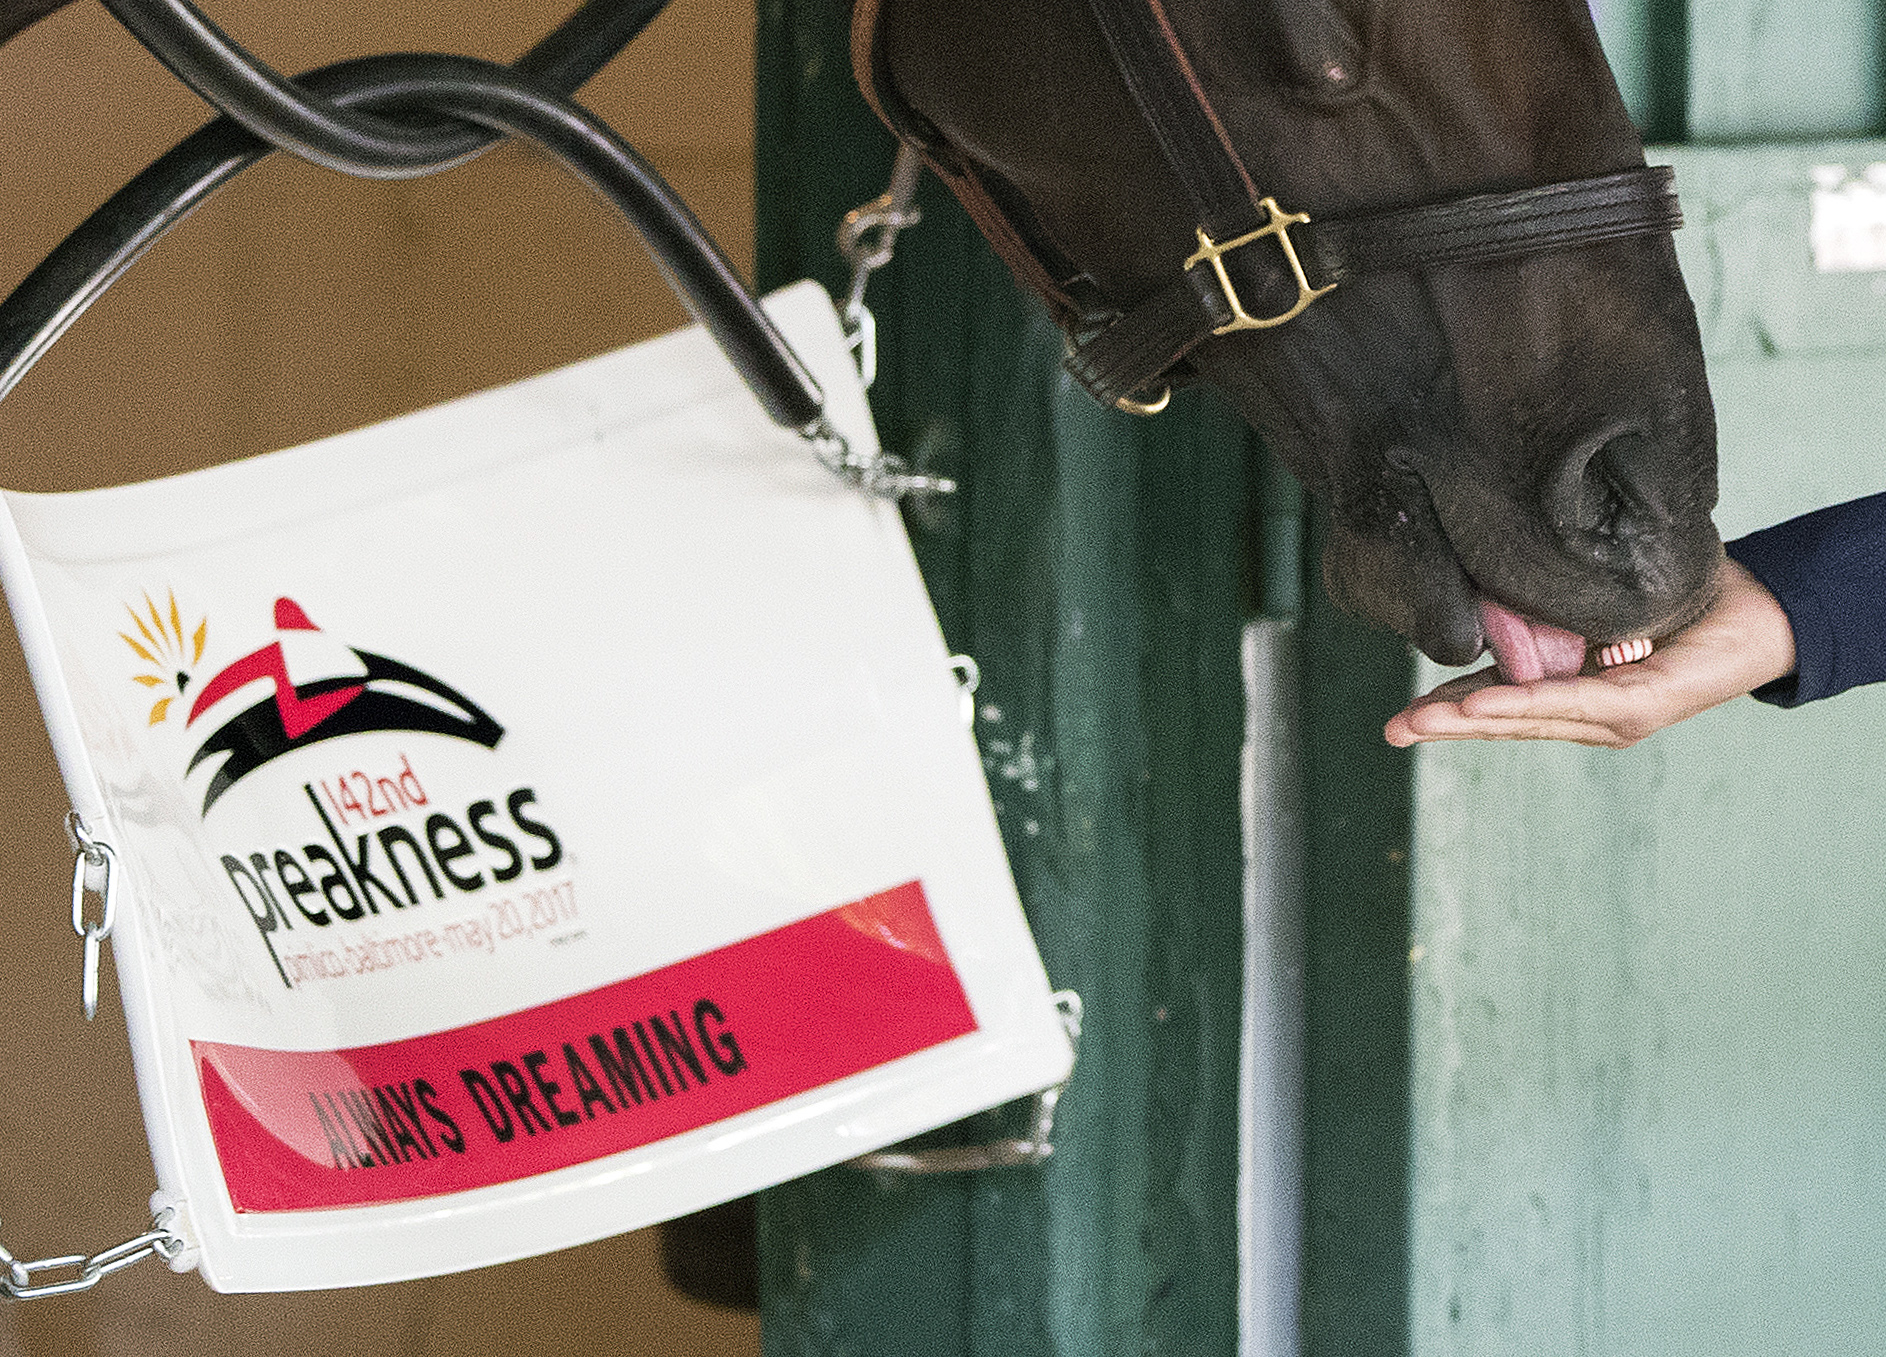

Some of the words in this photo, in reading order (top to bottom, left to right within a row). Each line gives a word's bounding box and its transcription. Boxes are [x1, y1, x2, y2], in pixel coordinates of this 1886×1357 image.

[323, 753, 430, 824] 142nd
[220, 784, 564, 989] preakness
[308, 1077, 466, 1172] ALWAYS
[459, 997, 749, 1144] DREAMING
